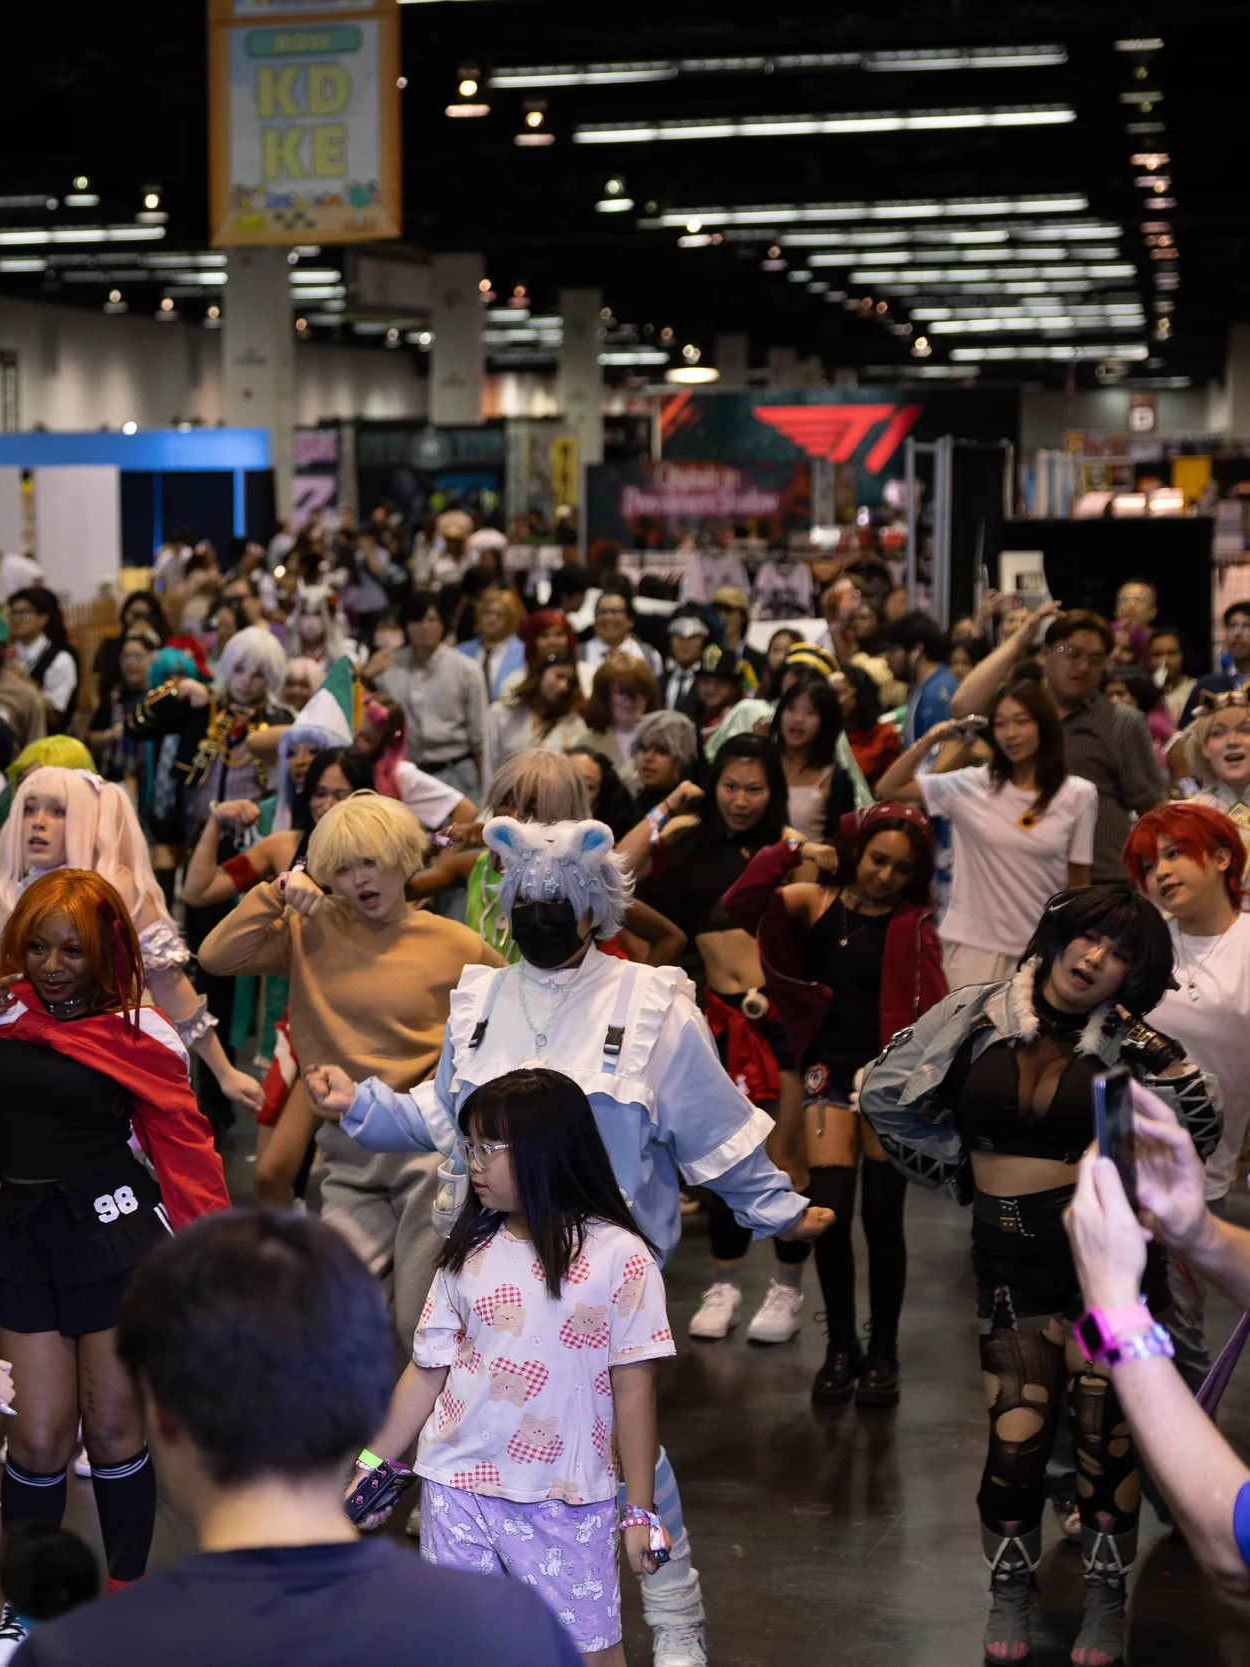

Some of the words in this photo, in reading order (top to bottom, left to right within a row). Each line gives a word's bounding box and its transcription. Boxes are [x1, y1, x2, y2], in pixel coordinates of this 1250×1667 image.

[256, 64, 351, 118] KD
[262, 123, 347, 179] KE
[93, 1185, 139, 1223] 98
